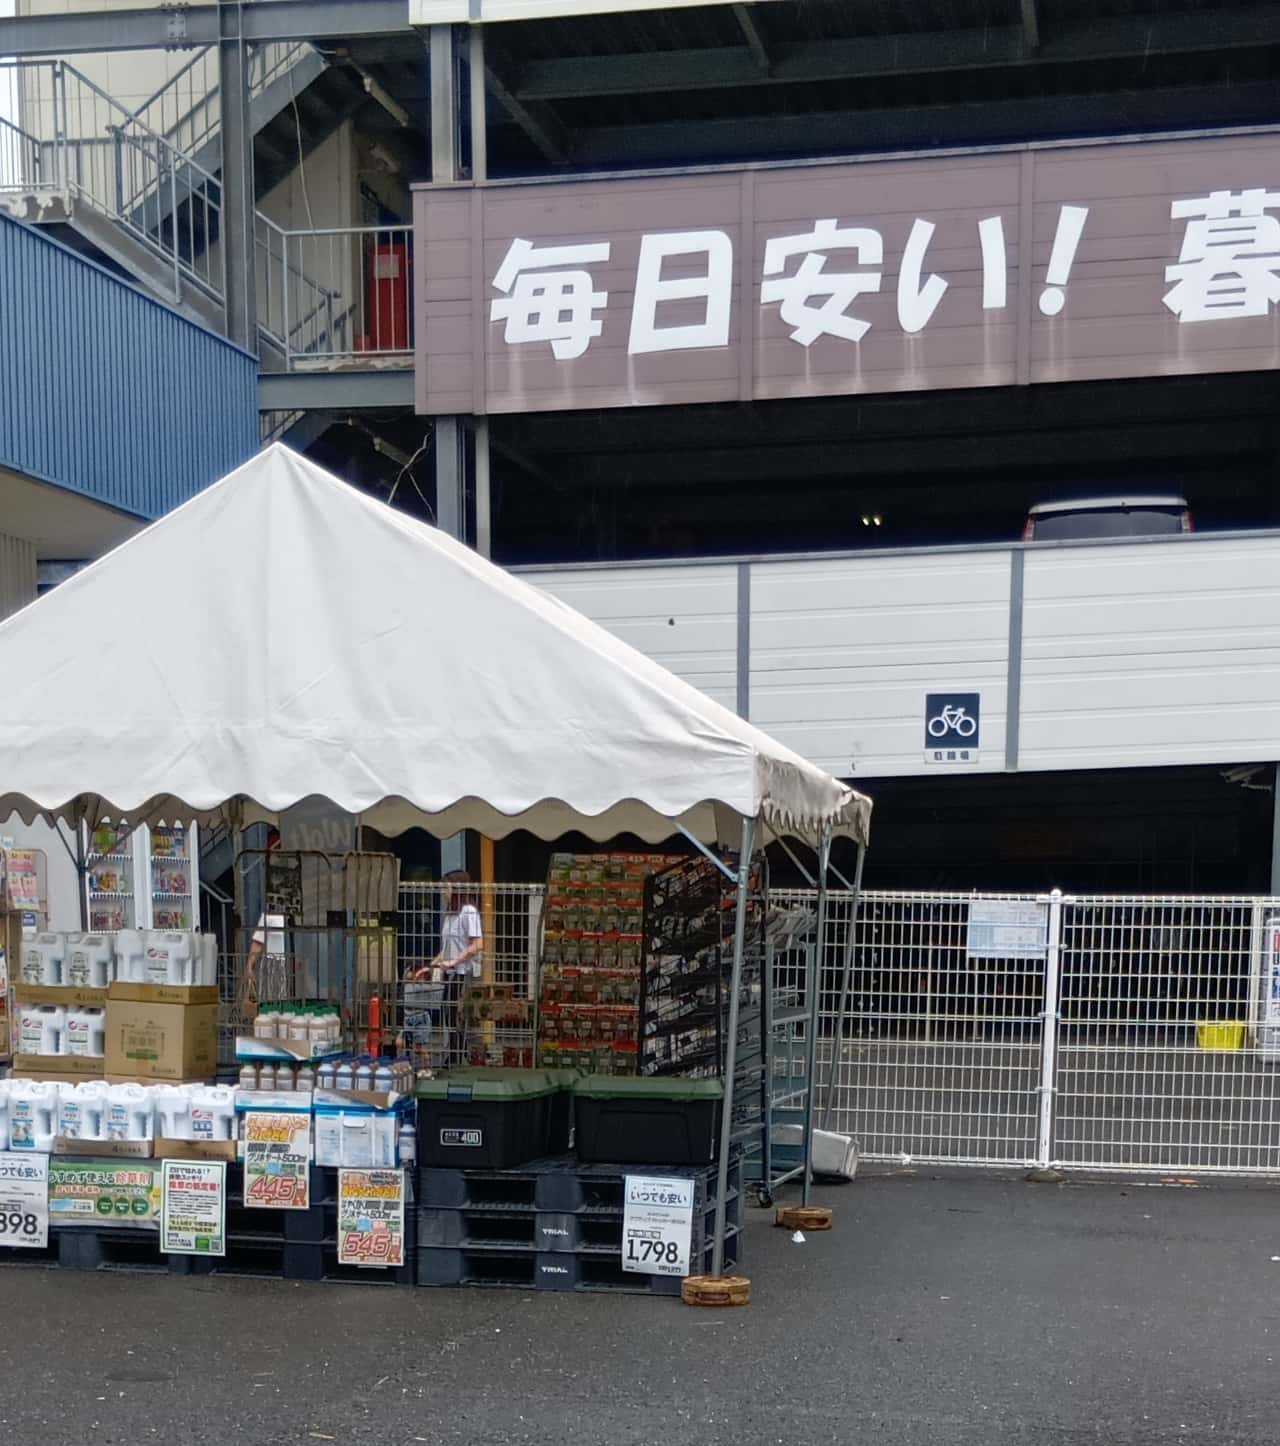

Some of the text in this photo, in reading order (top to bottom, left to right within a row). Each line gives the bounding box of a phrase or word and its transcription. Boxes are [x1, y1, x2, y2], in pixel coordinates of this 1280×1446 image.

[490, 203, 1090, 362] 毎日安い!
[541, 1227, 569, 1236] TRIAL
[540, 1265, 569, 1274] TRIAL
